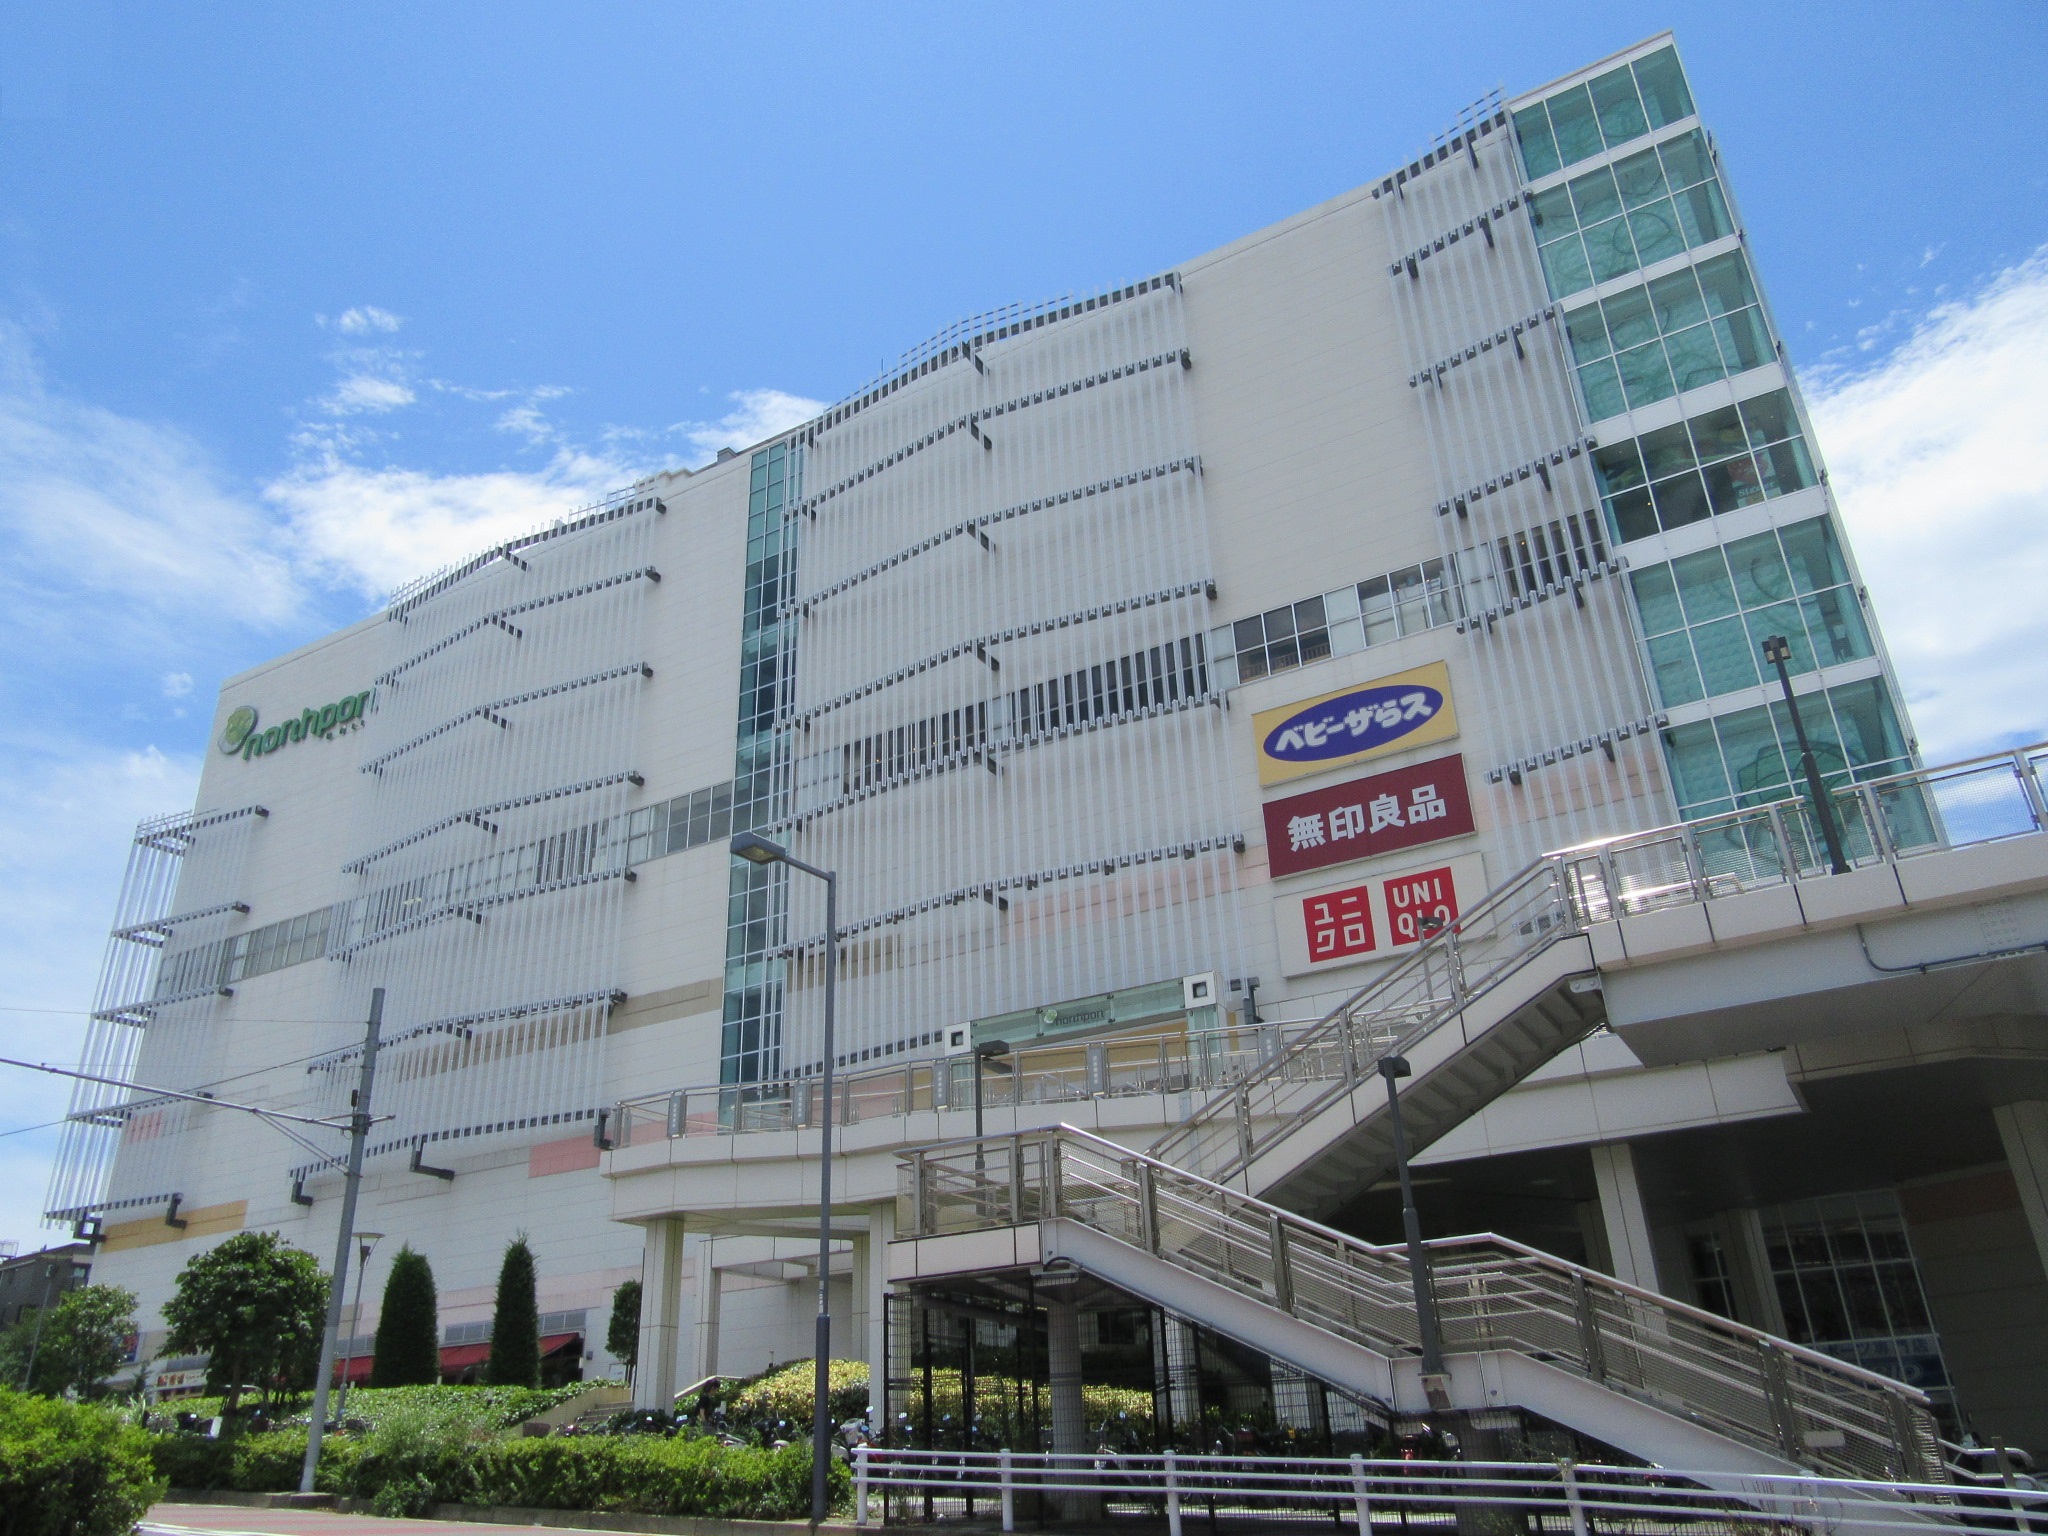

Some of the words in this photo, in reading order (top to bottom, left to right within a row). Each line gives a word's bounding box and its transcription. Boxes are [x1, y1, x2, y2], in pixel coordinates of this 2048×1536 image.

[1274, 691, 1434, 752] ベビーザらス
[1286, 783, 1448, 852] 無印良品
[1392, 877, 1442, 908] UNI
[1314, 894, 1362, 926] ユニ
[1315, 922, 1366, 954] クロ
[1055, 1009, 1105, 1026] northport
